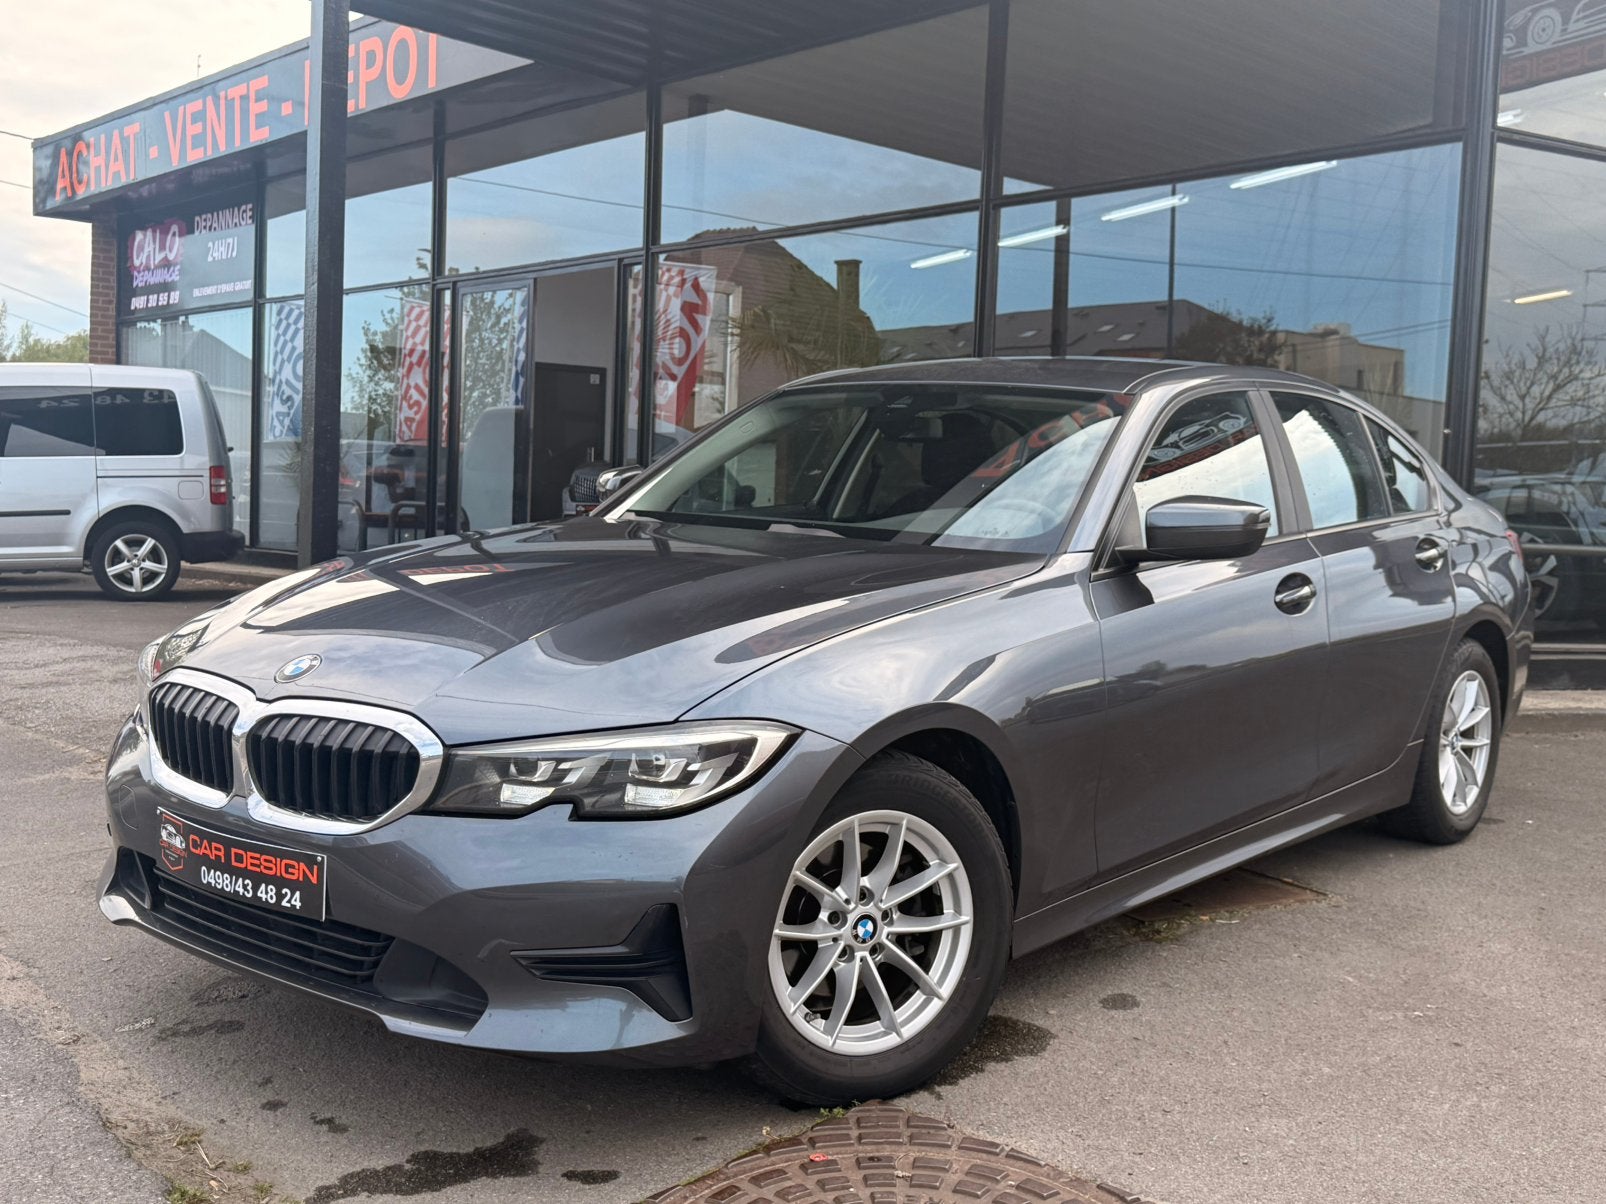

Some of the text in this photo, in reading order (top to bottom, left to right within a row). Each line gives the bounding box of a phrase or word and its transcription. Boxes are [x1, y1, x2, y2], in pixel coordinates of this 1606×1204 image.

[55, 121, 141, 204] ACHAT
[164, 75, 270, 166] VENTE
[194, 203, 253, 235] DEPANNAGE
[132, 224, 180, 270] CALO
[207, 237, 237, 262] 24H/7J
[189, 833, 318, 885] CAR DESIGN
[200, 865, 302, 910] 0498/43 48 24
